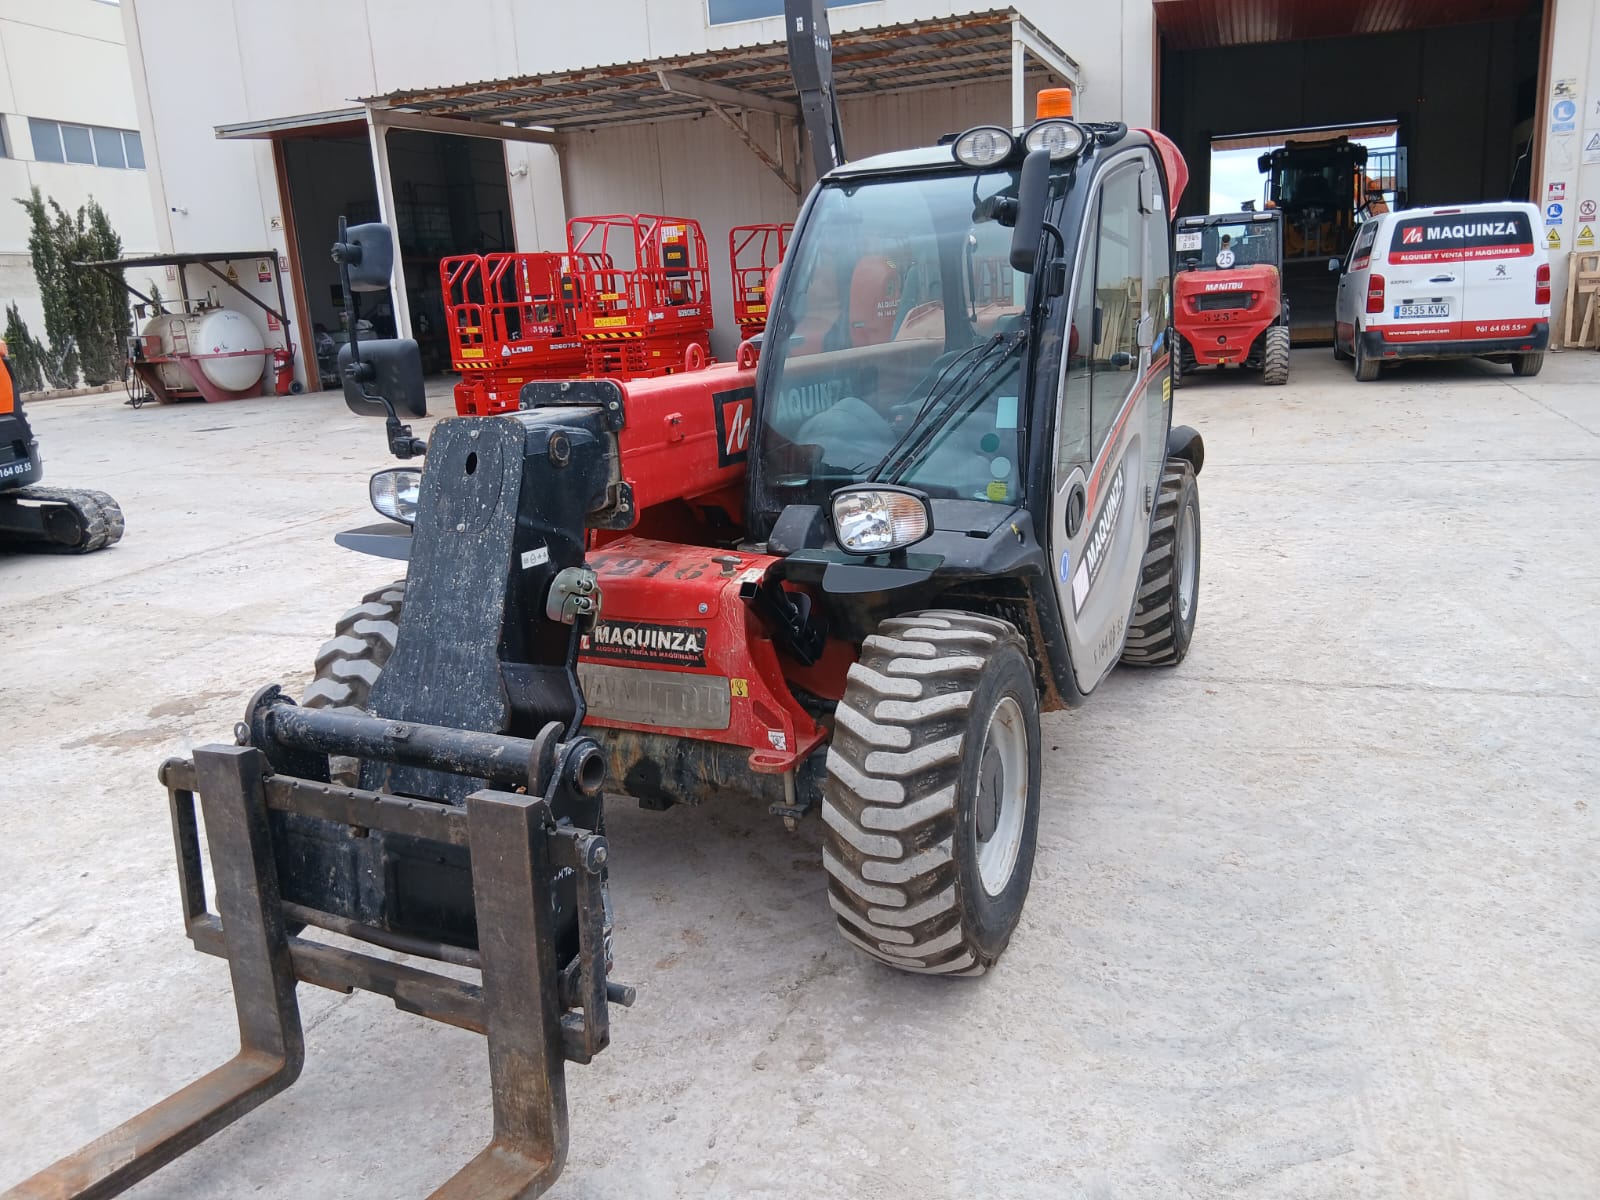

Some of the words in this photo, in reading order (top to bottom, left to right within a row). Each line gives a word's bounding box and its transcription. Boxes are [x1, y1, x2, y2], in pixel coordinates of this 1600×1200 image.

[1427, 222, 1517, 240] MAQUINZA
[1220, 253, 1231, 264] 25
[1400, 253, 1432, 261] ALQUILER
[1475, 248, 1520, 257] MAQUINARIA
[1205, 282, 1243, 291] MANITOU
[1401, 305, 1425, 315] 9535
[1428, 304, 1446, 314] KVK
[1388, 328, 1450, 336] www.maquinza.com
[15, 464, 23, 474] 05
[24, 462, 32, 472] 55
[1087, 468, 1123, 573] MAQUINZA
[594, 626, 703, 652] MAQUINZA
[659, 651, 699, 661] MAQUINARIA
